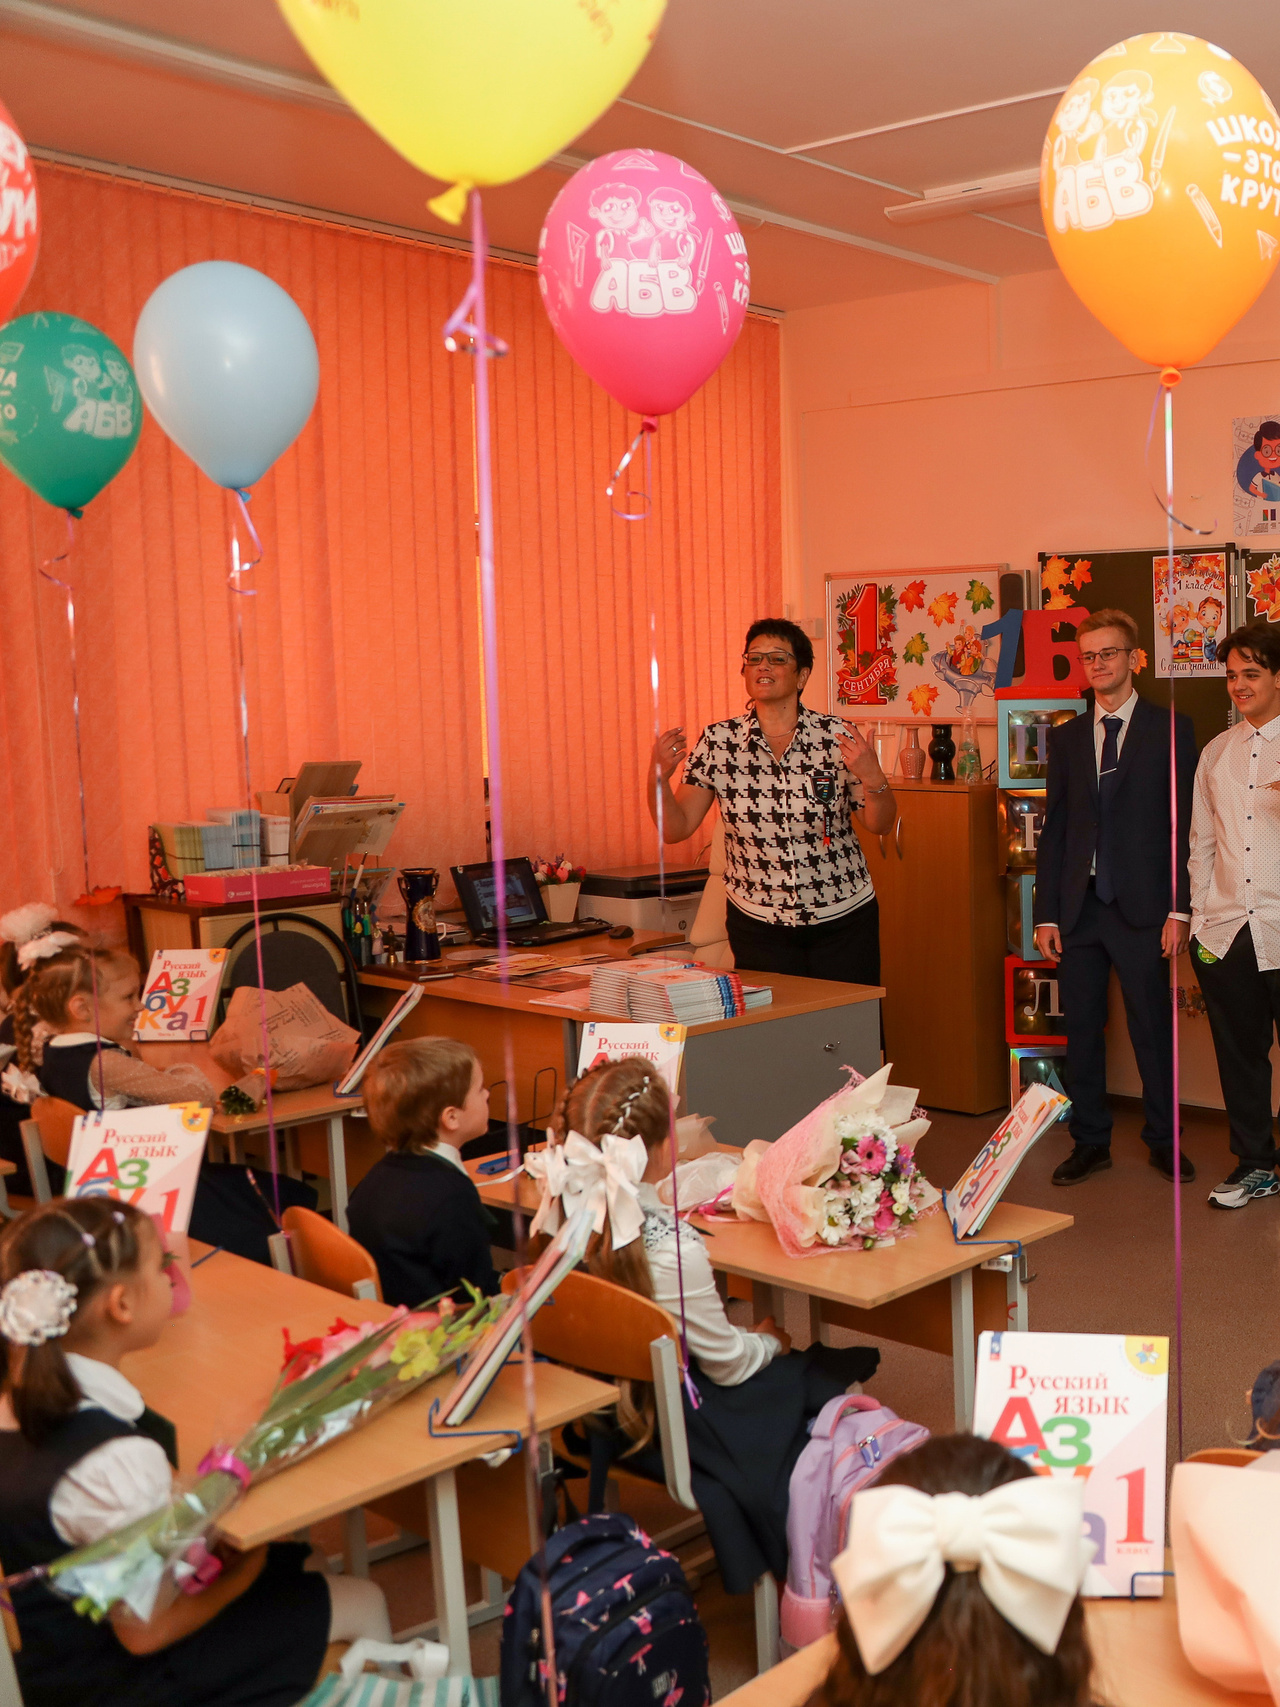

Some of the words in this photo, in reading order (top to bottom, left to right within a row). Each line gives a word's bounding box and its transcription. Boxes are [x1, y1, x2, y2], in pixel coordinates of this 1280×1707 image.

[1053, 152, 1153, 233] АБВ
[590, 258, 698, 318] АБВ
[63, 400, 133, 439] АБВ
[843, 659, 890, 692] СЕНТЯБРЯ
[162, 960, 202, 971] Русский
[192, 995, 208, 1022] 1
[597, 1037, 649, 1052] Русский
[103, 1128, 167, 1146] Русский
[160, 1187, 180, 1233] 1
[1008, 1365, 1108, 1395] Русский
[1116, 1467, 1154, 1544] 1
